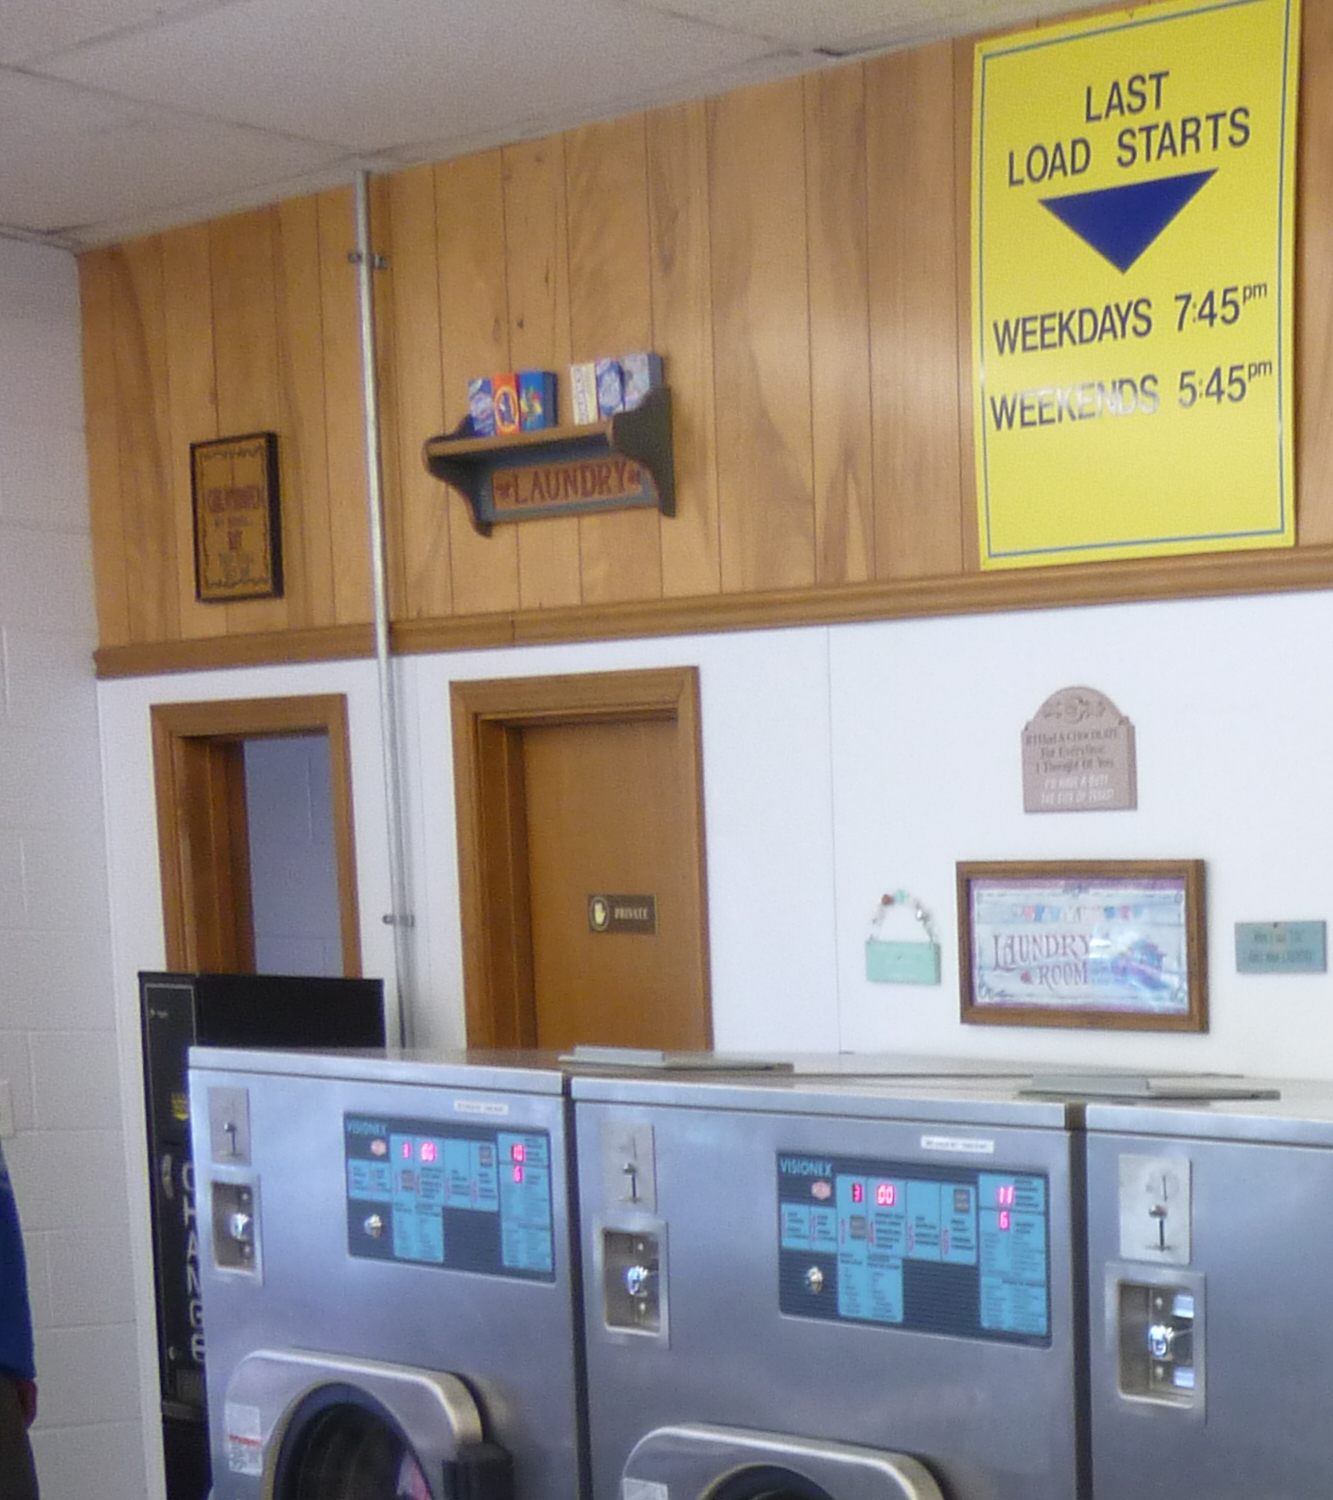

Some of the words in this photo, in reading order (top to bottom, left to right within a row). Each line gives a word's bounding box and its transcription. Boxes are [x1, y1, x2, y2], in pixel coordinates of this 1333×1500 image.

[1085, 69, 1170, 124] LAST
[1008, 138, 1091, 187] LOAD
[1117, 106, 1250, 168] STARTS
[993, 298, 1152, 356] WEEKDAYS
[990, 374, 1158, 431] WEEKENDS
[514, 459, 627, 504] LAUNDRY
[993, 934, 1092, 971] LAUNDRY
[1039, 961, 1089, 991] ROOM
